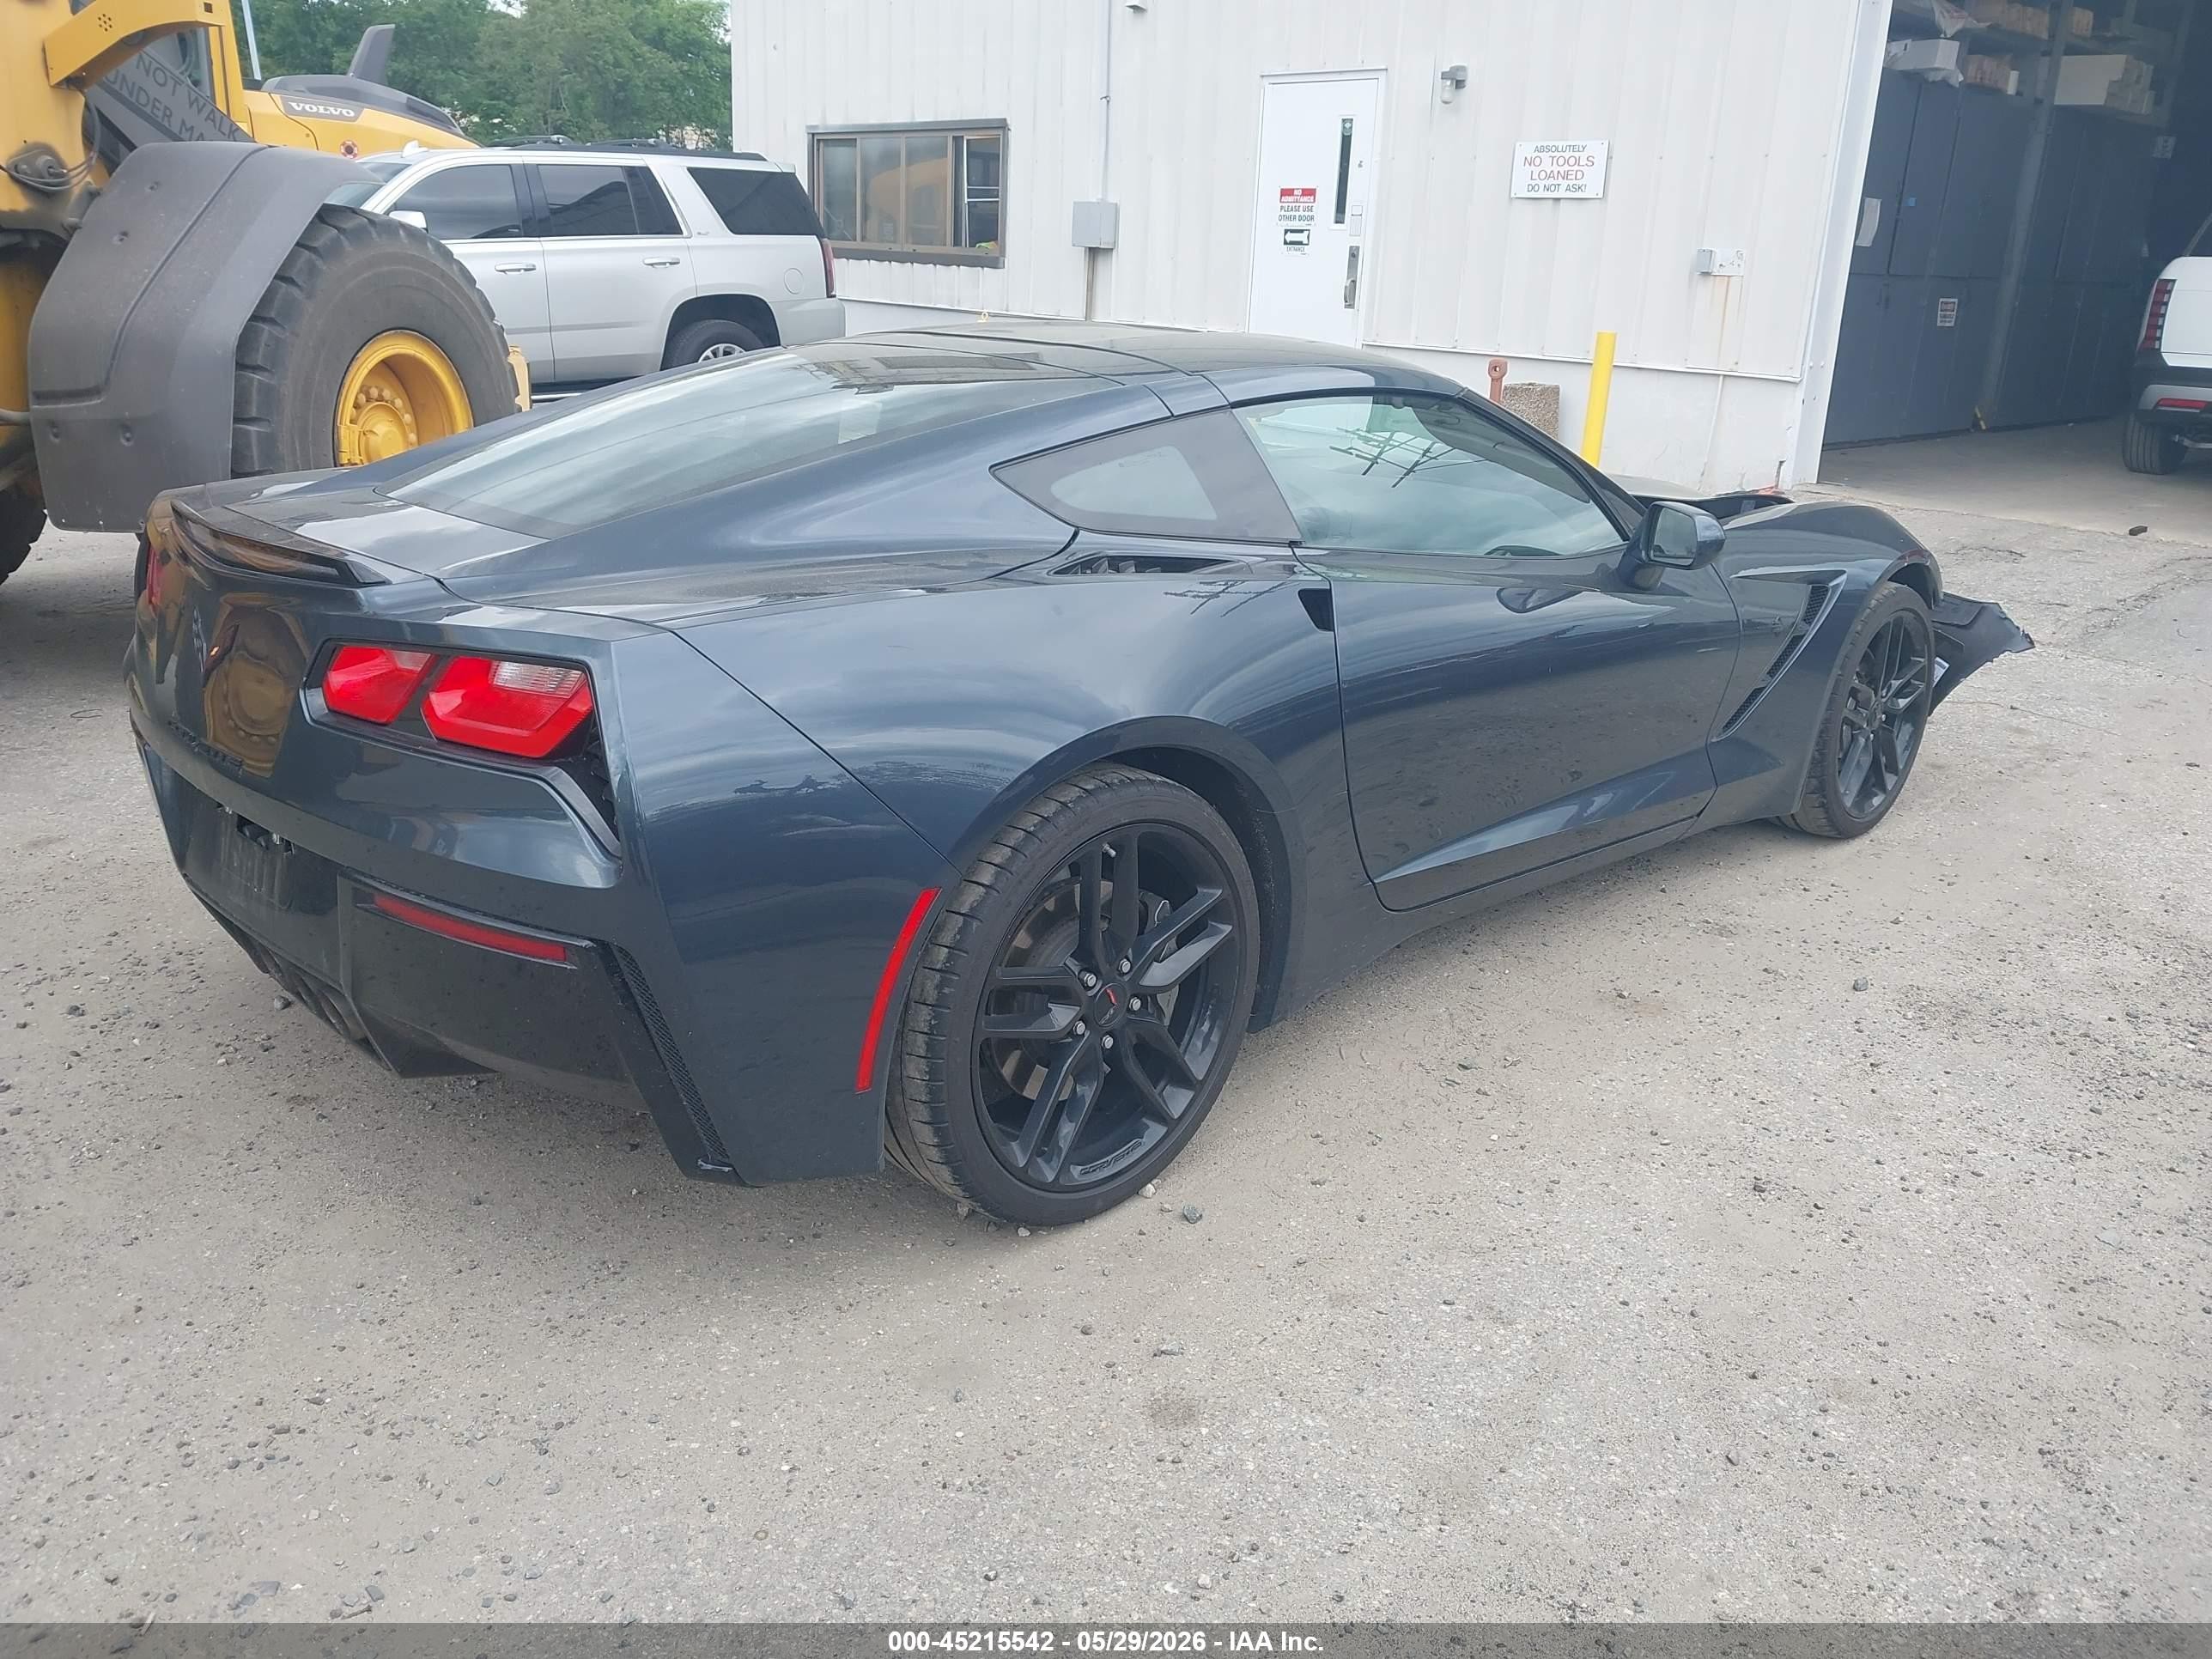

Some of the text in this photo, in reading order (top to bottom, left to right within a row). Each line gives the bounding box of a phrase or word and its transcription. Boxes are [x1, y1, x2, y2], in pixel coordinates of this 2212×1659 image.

[105, 69, 173, 127] UNDER
[136, 52, 240, 141] NOT WALK
[288, 101, 356, 118] VOLVO
[1534, 144, 1587, 153] ABSOLUTELY
[1523, 155, 1595, 167] NO TOOLS
[1530, 169, 1585, 181] LOANED
[1527, 184, 1587, 192] DO NOT ASK!
